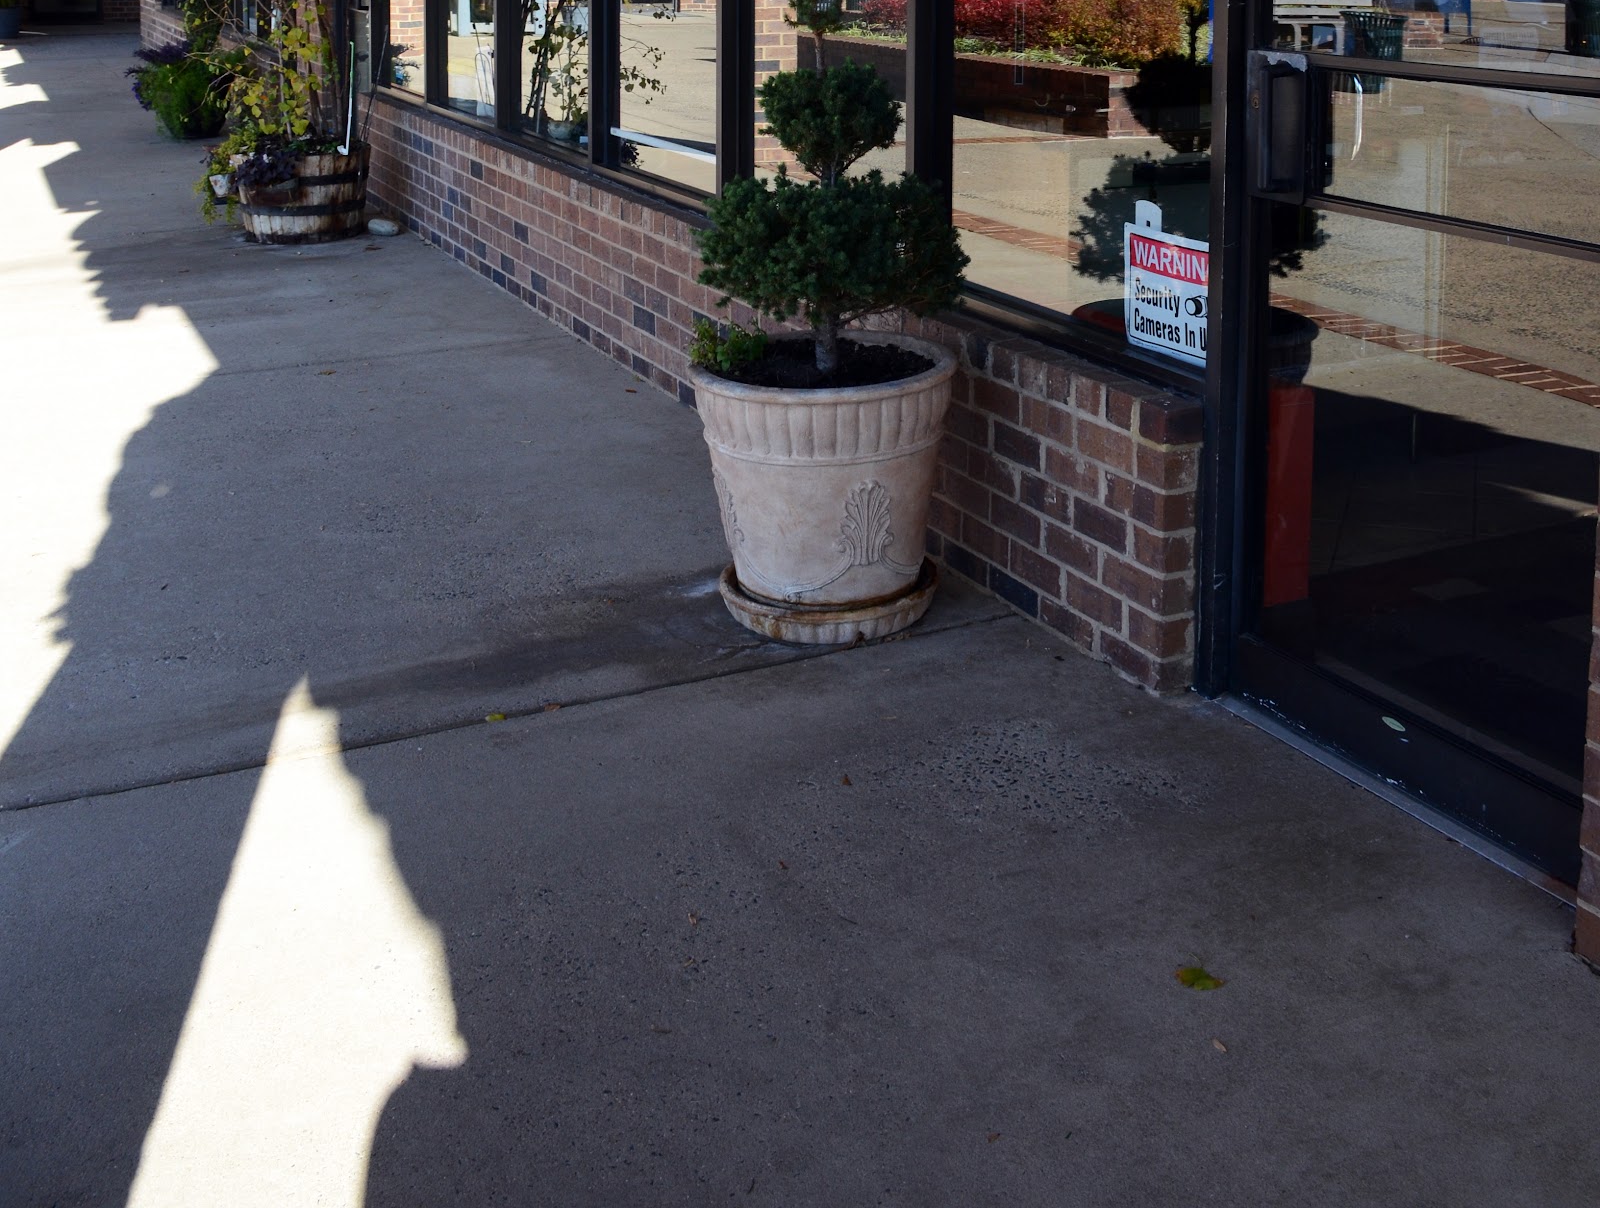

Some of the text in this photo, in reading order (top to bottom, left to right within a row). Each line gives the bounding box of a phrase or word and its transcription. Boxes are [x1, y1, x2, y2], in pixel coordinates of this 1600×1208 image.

[1133, 239, 1208, 282] WARNIN
[1134, 277, 1180, 317] Security
[1134, 307, 1181, 344] Cameras
[1184, 322, 1196, 349] In
